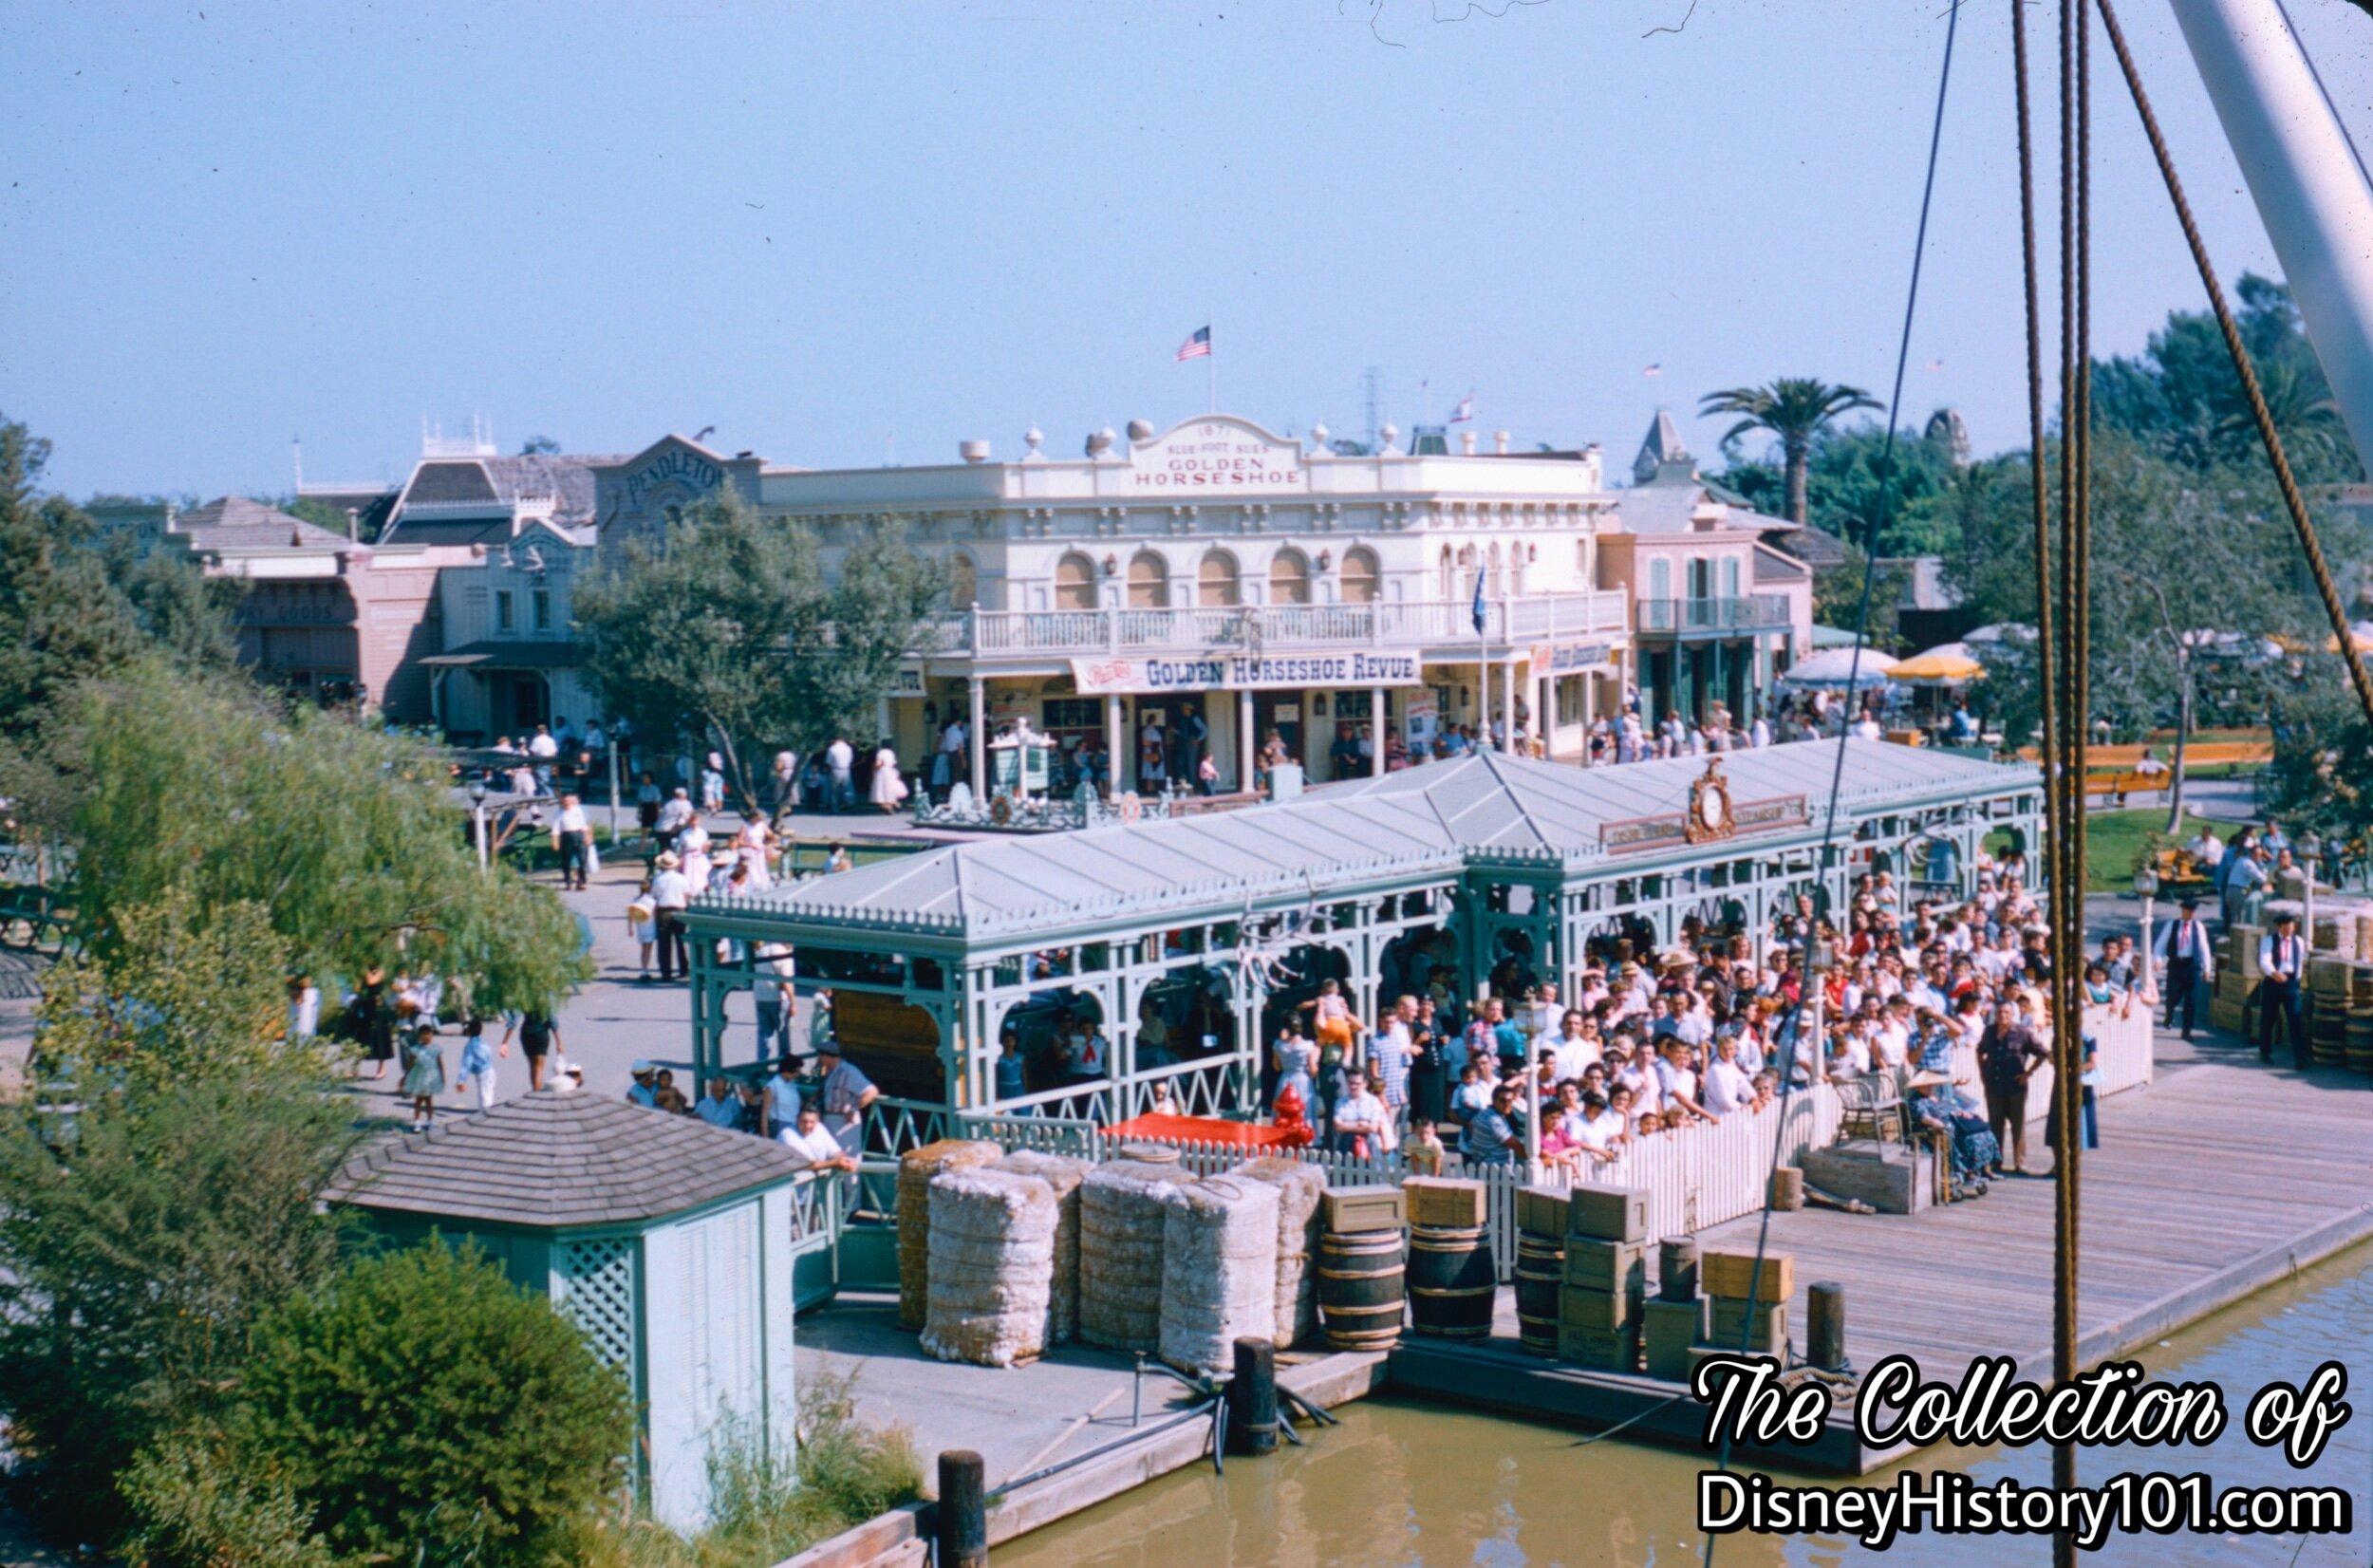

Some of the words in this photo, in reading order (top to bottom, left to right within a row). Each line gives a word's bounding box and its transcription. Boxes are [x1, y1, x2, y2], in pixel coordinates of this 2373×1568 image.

[1168, 457, 1264, 471] GOLDEN
[1135, 471, 1299, 486] HORSESHOE
[1146, 659, 1224, 686] GOLDEN
[1231, 656, 1346, 683] HORSESHOE
[1353, 653, 1414, 681] REVUE
